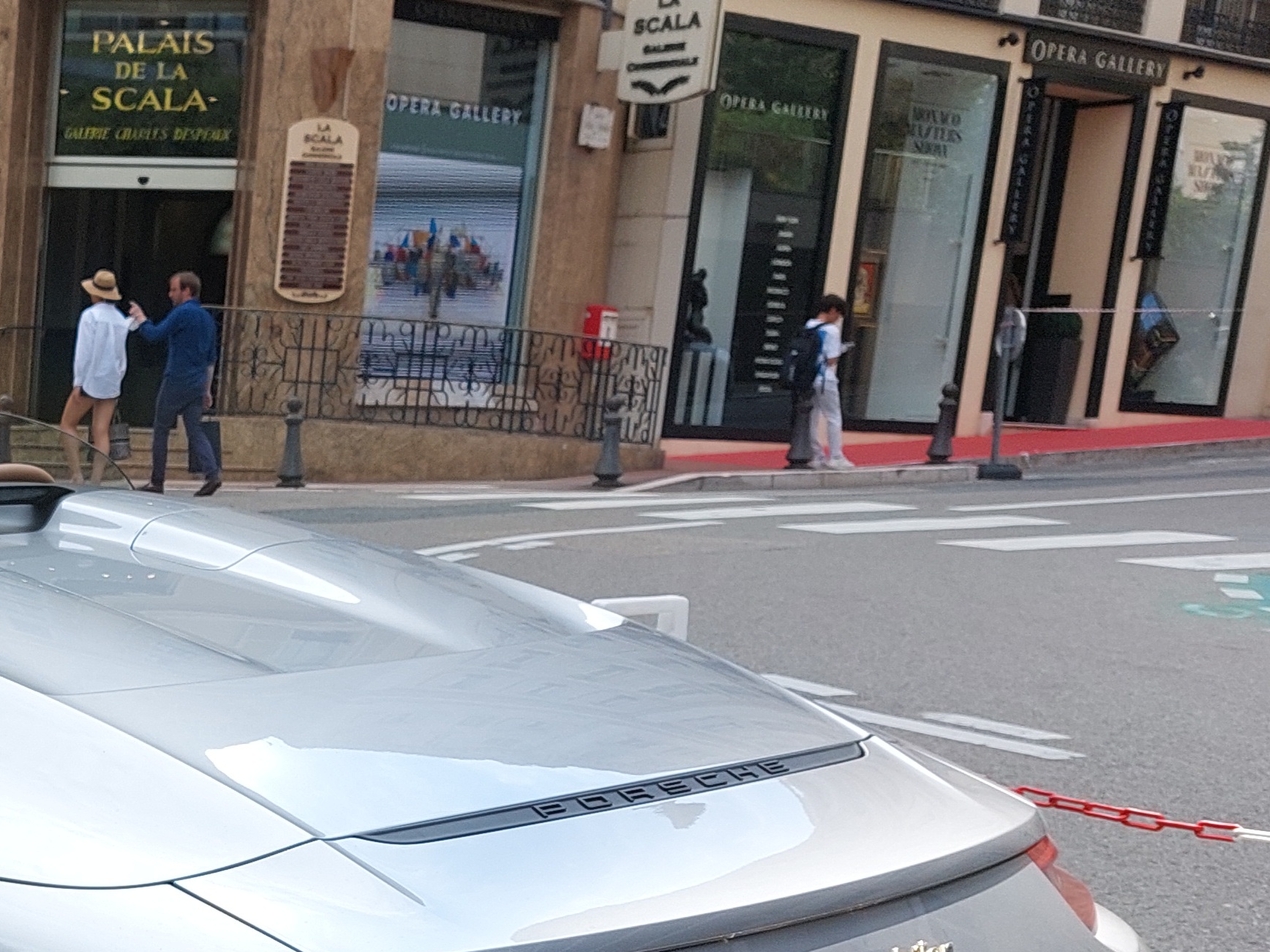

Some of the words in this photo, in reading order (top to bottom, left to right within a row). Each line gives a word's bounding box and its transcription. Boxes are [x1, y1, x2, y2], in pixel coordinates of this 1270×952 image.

[634, 11, 701, 35] SCALA
[92, 29, 215, 55] PALAIS
[115, 61, 146, 80] DE
[156, 61, 188, 80] LA
[1031, 39, 1088, 66] OPERA
[1094, 51, 1167, 78] GALLERY
[92, 86, 208, 112] SCALA
[386, 93, 441, 117] OPERA
[449, 101, 523, 126] GALLERY
[720, 92, 766, 112] OPERA
[530, 759, 791, 819] PORSCHE
